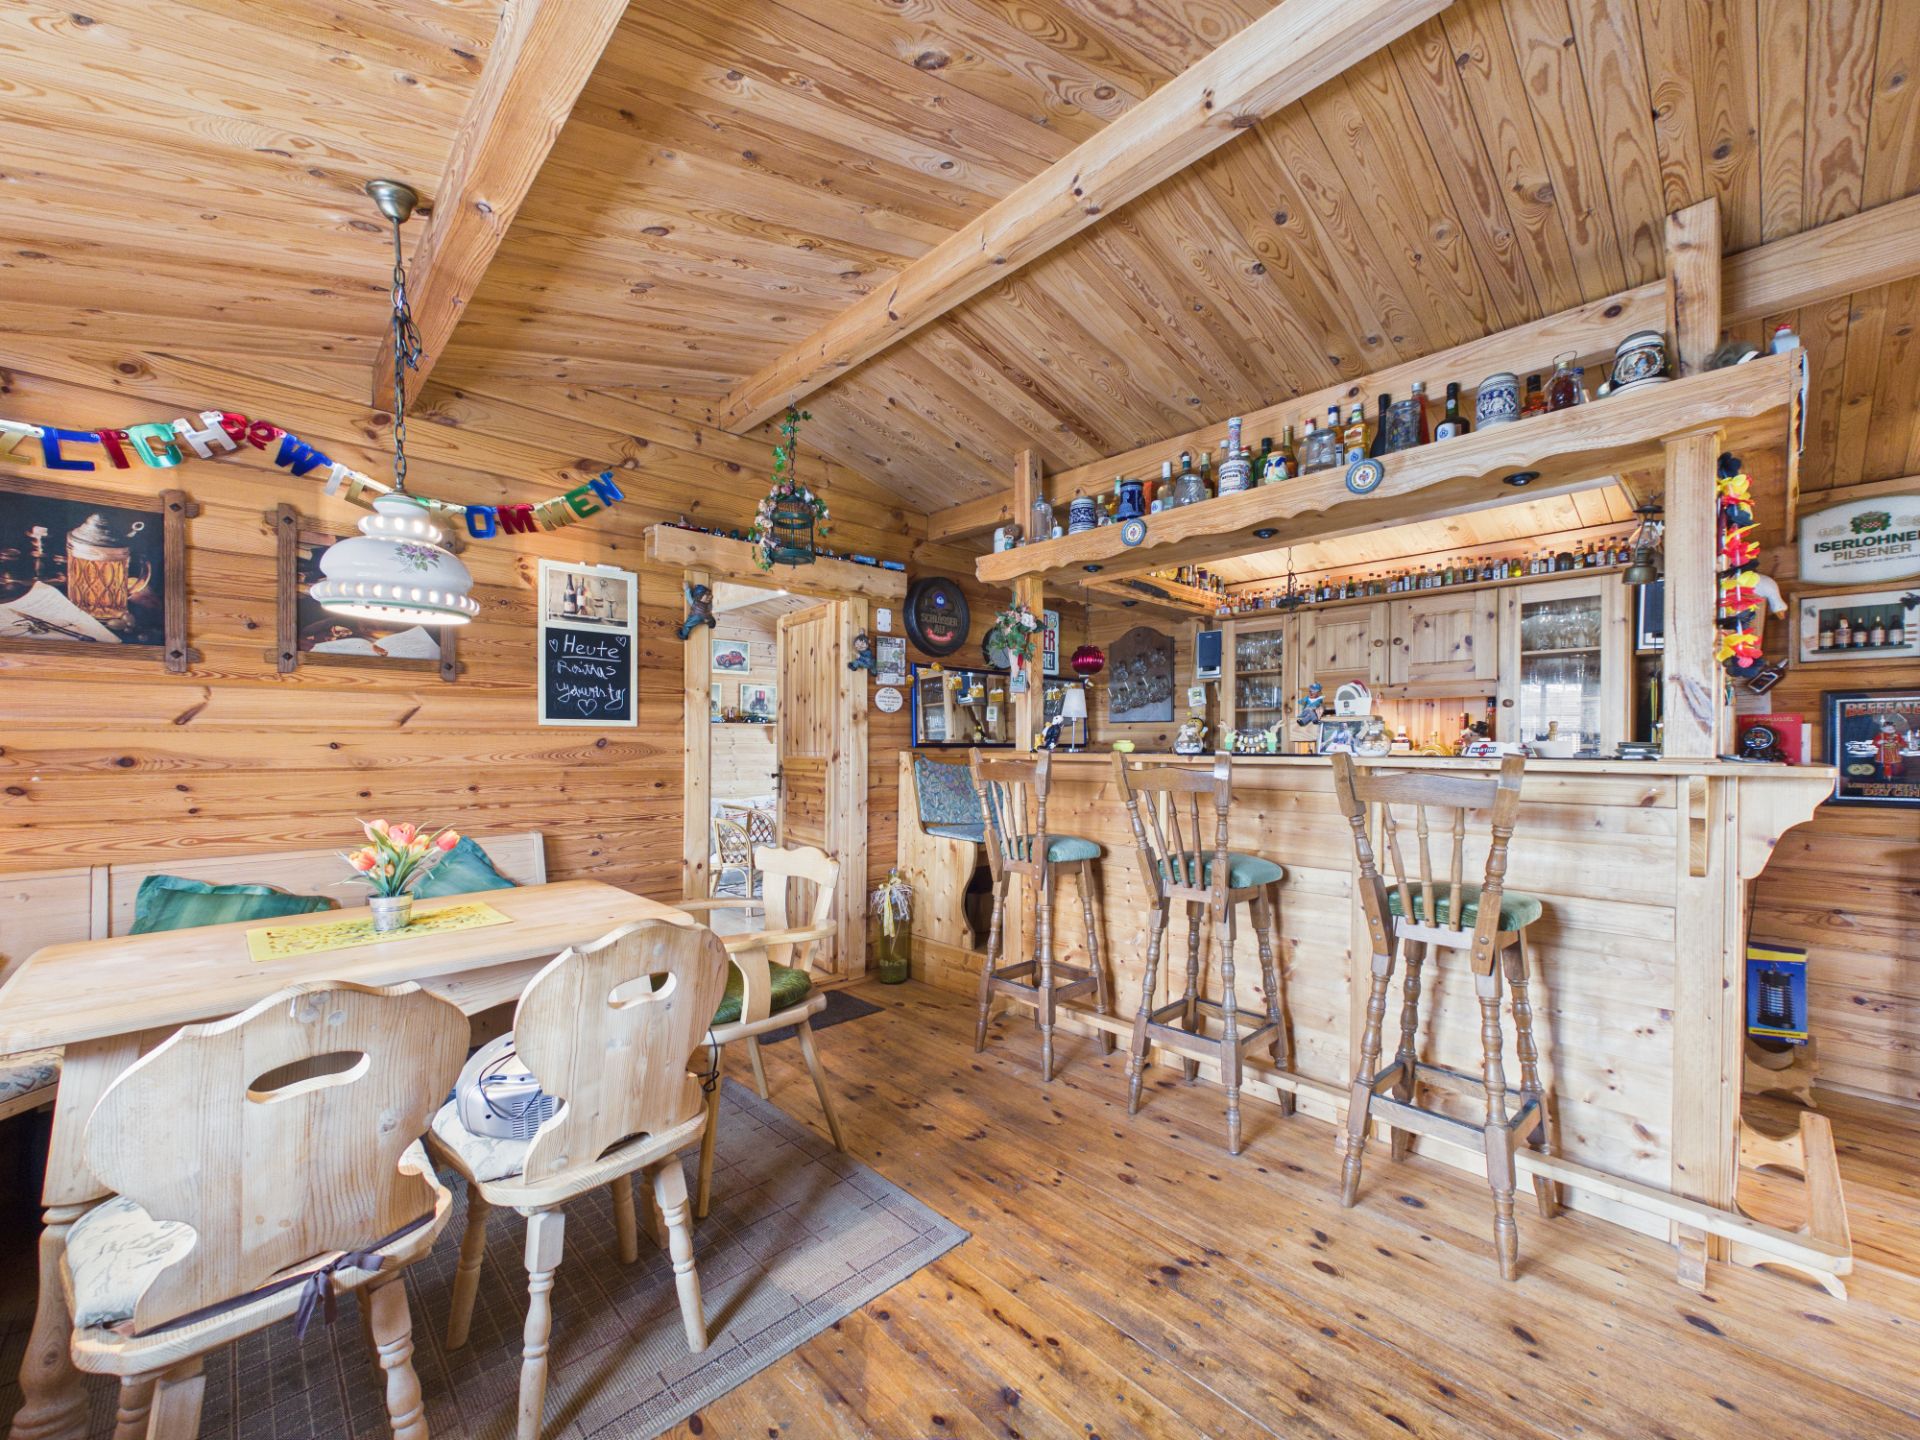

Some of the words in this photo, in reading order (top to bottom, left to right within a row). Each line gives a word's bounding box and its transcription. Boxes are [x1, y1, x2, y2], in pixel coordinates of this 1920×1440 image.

[275, 433, 624, 539] WILKOMMEN
[1814, 530, 1920, 553] ISERLOHNE
[1833, 543, 1912, 561] PILSENER
[563, 634, 620, 659] Heute
